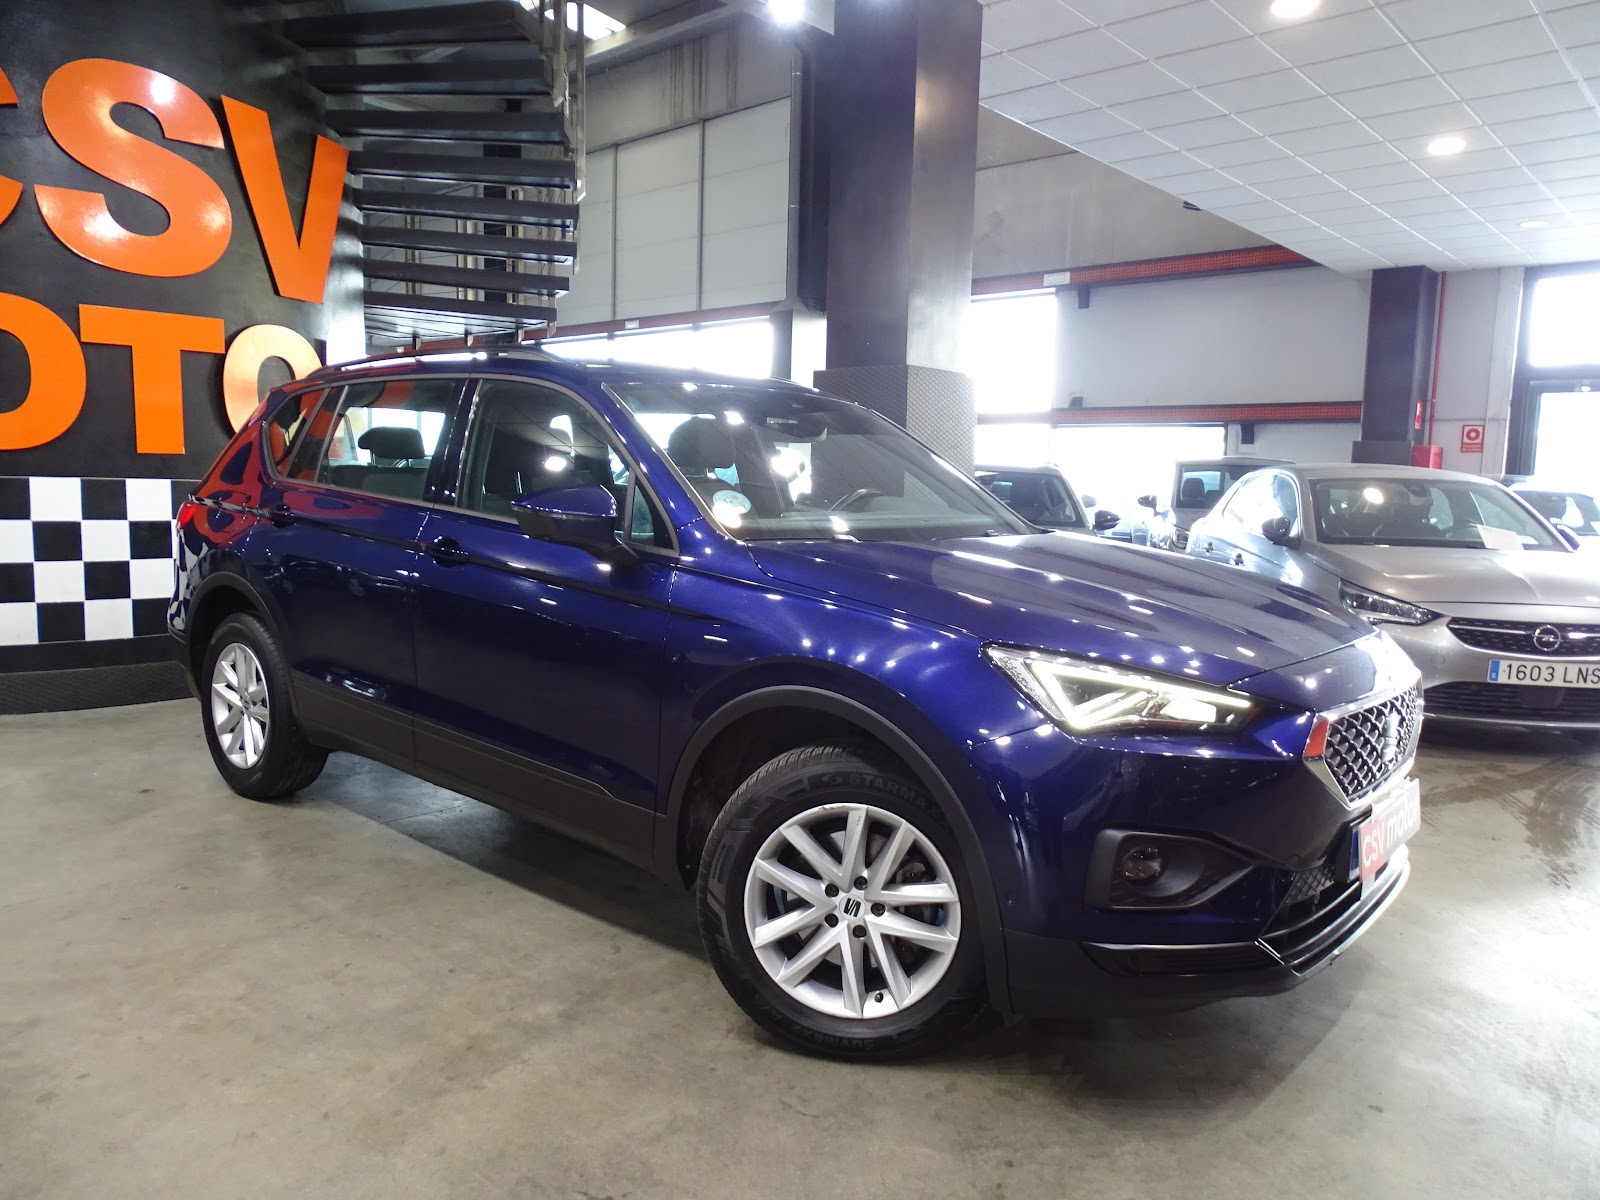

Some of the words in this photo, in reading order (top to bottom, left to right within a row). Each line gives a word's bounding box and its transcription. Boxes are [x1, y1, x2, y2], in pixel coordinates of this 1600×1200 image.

[0, 58, 348, 304] SV
[1506, 663, 1555, 682] 1603
[1563, 666, 1600, 684] LNS
